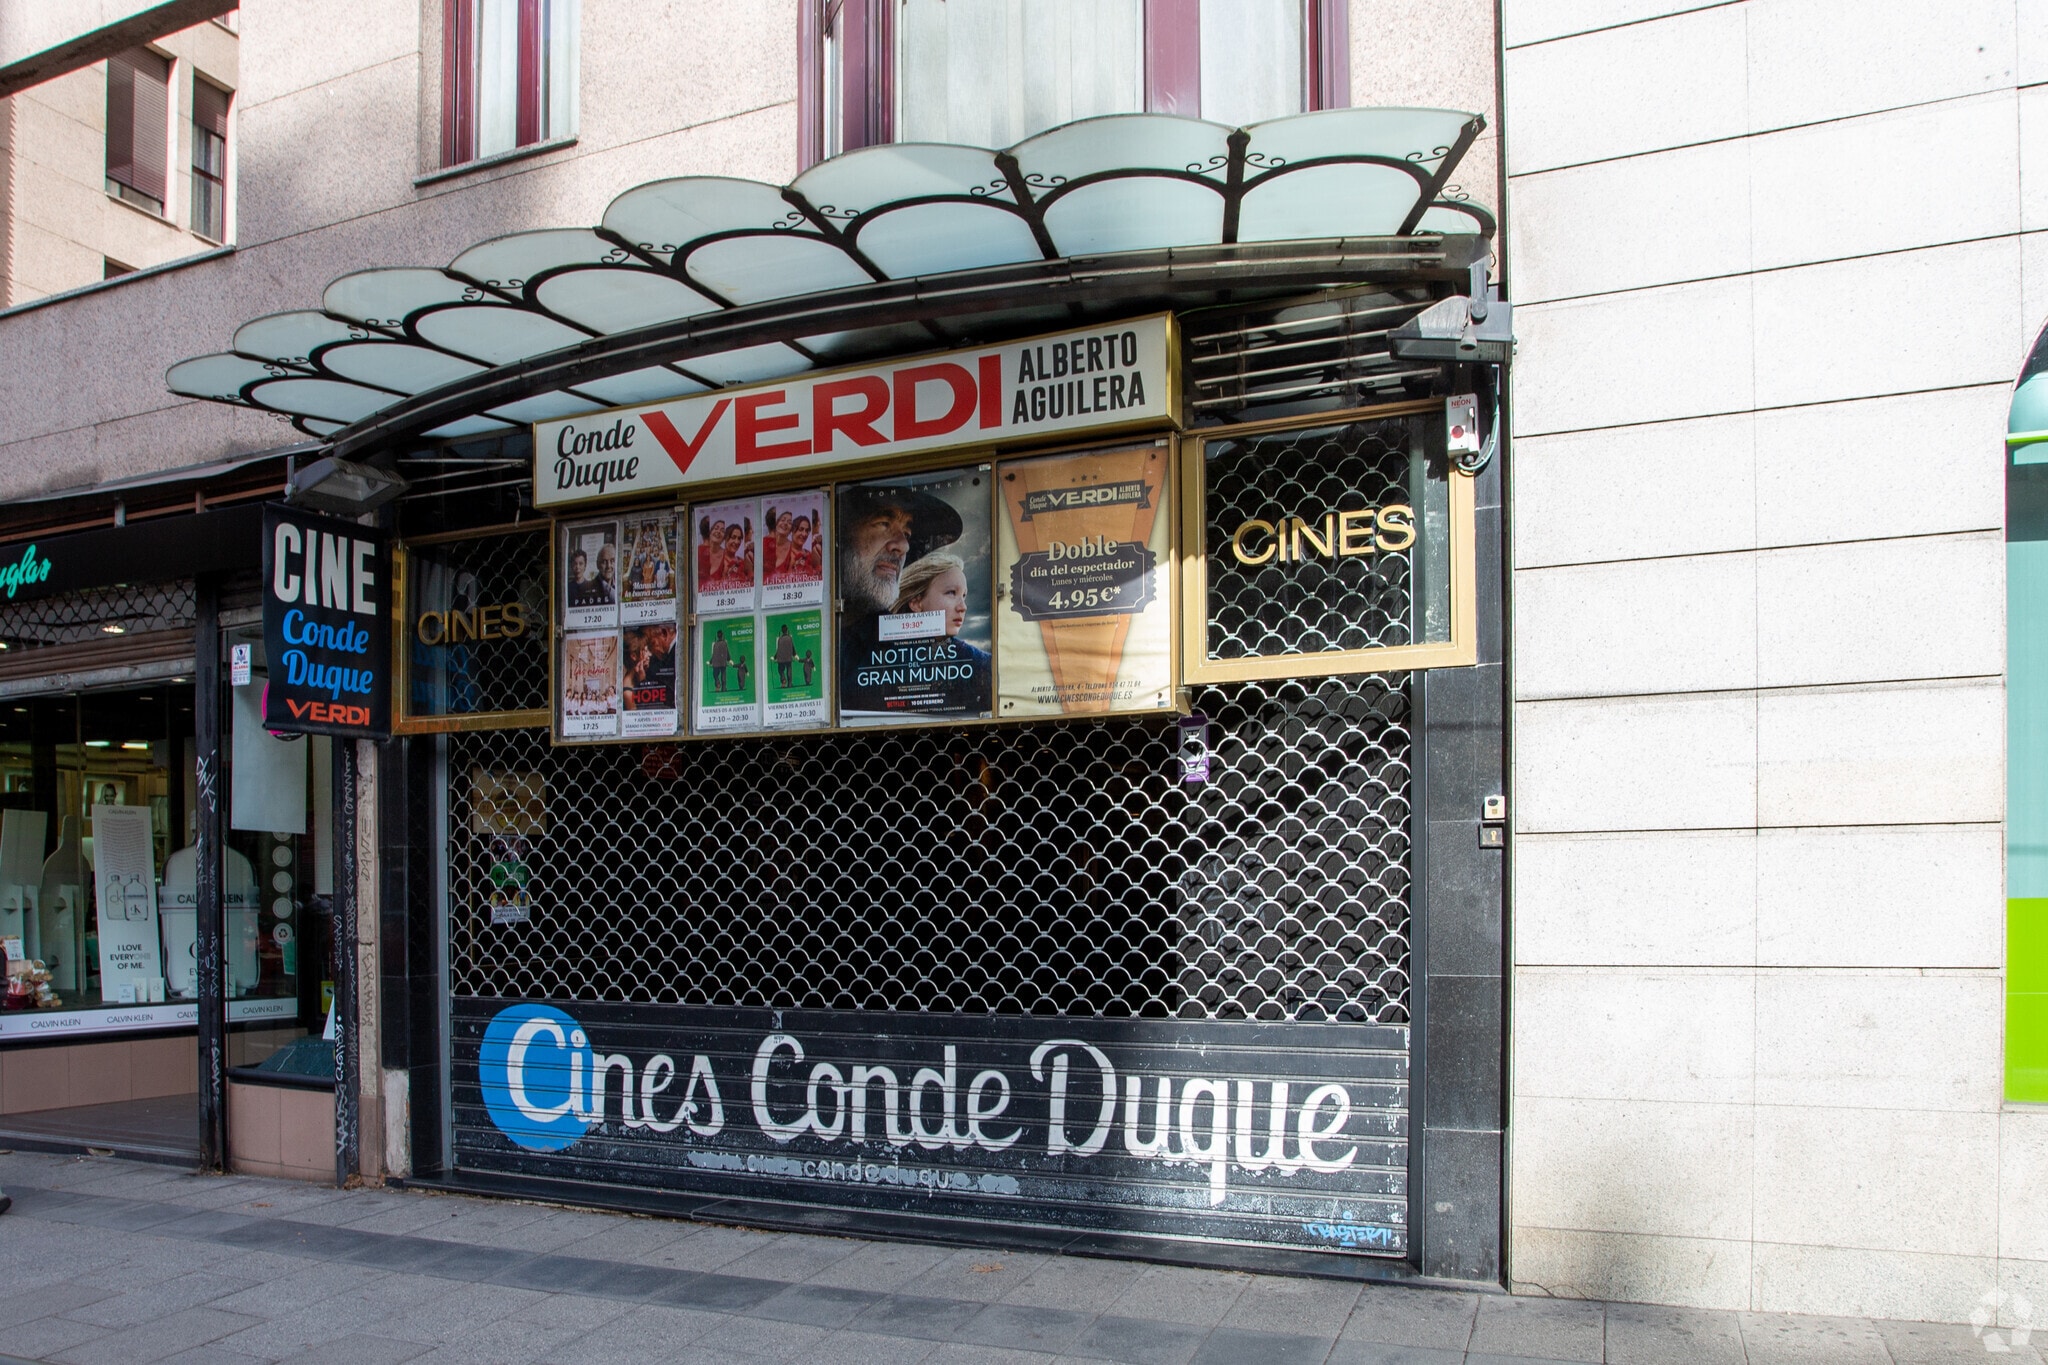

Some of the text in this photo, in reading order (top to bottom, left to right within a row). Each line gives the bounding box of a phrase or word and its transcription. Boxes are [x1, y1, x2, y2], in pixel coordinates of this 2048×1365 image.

[1018, 331, 1138, 384] ALBERTO
[1012, 370, 1146, 425] AGUILERA
[1451, 399, 1472, 407] NEON
[557, 354, 1002, 475] Conde VERDI
[553, 456, 639, 493] Duque
[869, 480, 964, 498] TOM HANKS
[1047, 487, 1118, 506] VERDI
[1118, 492, 1142, 500] AGUILERA
[1119, 484, 1141, 493] ALBERTO
[1232, 504, 1417, 566] CINES
[1047, 535, 1118, 562] Doble
[274, 522, 377, 616] CINE
[1030, 559, 1135, 578] día del espectador
[1051, 573, 1114, 586] Lunes y miércoles
[716, 597, 735, 606] 18:30
[782, 591, 803, 600] 18:30
[418, 602, 525, 646] CINES
[584, 615, 602, 623] 17:20
[884, 613, 904, 621] VIERNES
[282, 609, 369, 654] Conde
[871, 644, 957, 665] NOTICIAS
[282, 649, 374, 700] Duque
[857, 664, 973, 686] GRAN MUNDO
[631, 688, 666, 703] HOPE
[286, 699, 370, 726] VERDI
[177, 893, 243, 904] CAL LEIN
[117, 962, 129, 970] OF
[107, 1013, 153, 1024] CALVIN KLEIN
[242, 1004, 284, 1015] CALVIN KLEIN
[31, 1017, 81, 1029] CALVIN KLEIN
[506, 1017, 1359, 1208] Cines Conde Duque
